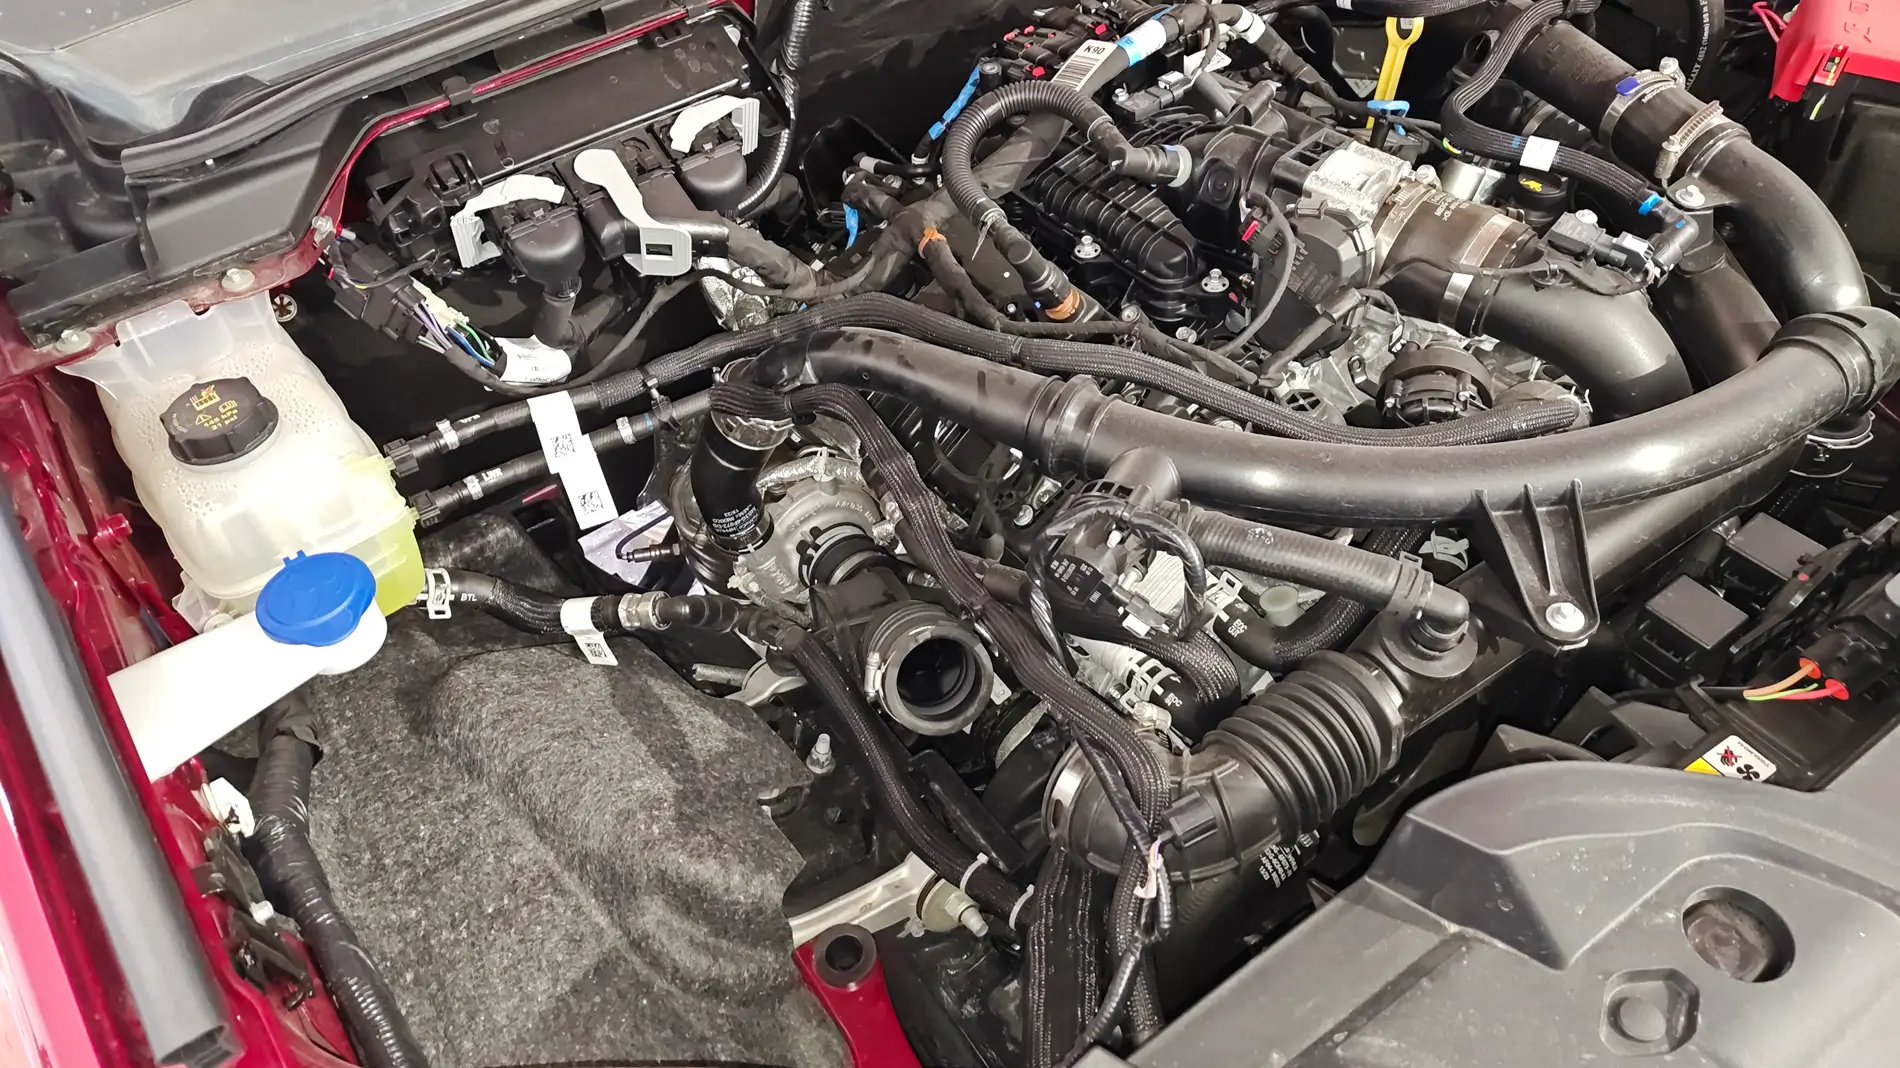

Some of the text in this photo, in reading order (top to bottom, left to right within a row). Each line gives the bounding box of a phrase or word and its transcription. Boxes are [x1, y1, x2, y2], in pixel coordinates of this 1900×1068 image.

[1083, 44, 1106, 55] K90
[221, 409, 238, 419] kPa
[211, 415, 238, 431] 21 psi
[481, 467, 504, 482] LWR
[460, 593, 477, 602] BTL
